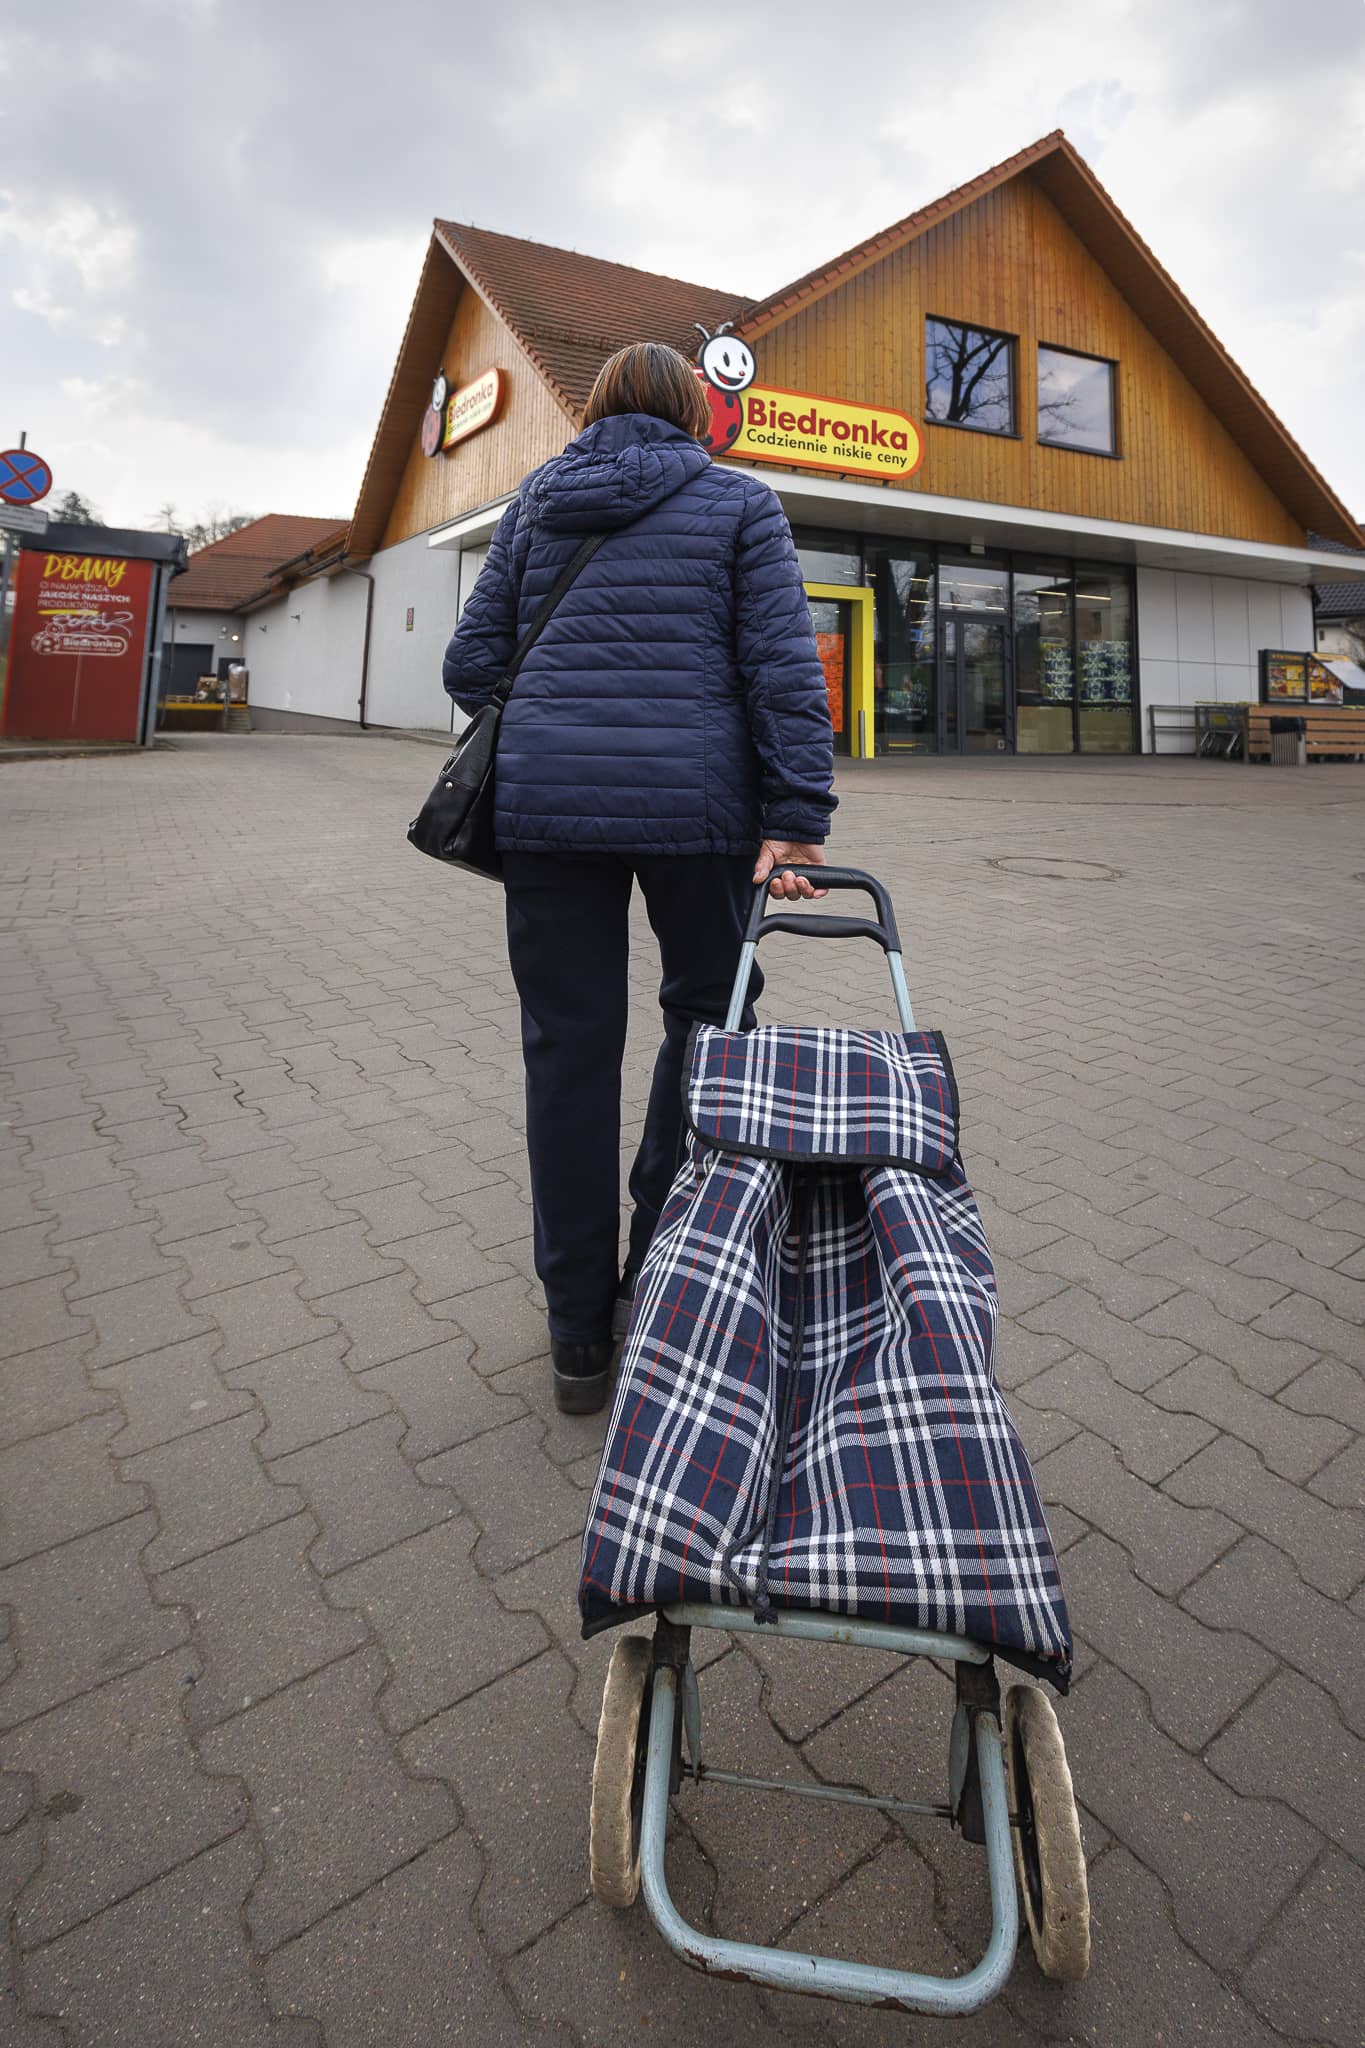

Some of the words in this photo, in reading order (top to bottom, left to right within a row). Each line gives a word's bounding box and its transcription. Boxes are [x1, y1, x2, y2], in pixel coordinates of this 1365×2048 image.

[448, 383, 493, 424] Biedronka
[747, 397, 908, 450] Biedronka
[746, 428, 828, 453] Codziennie
[833, 443, 872, 460] niskie
[877, 452, 908, 468] ceny
[43, 554, 127, 588] DBAMY
[82, 593, 130, 602] NASZYCH
[63, 638, 122, 648] Biedronka
